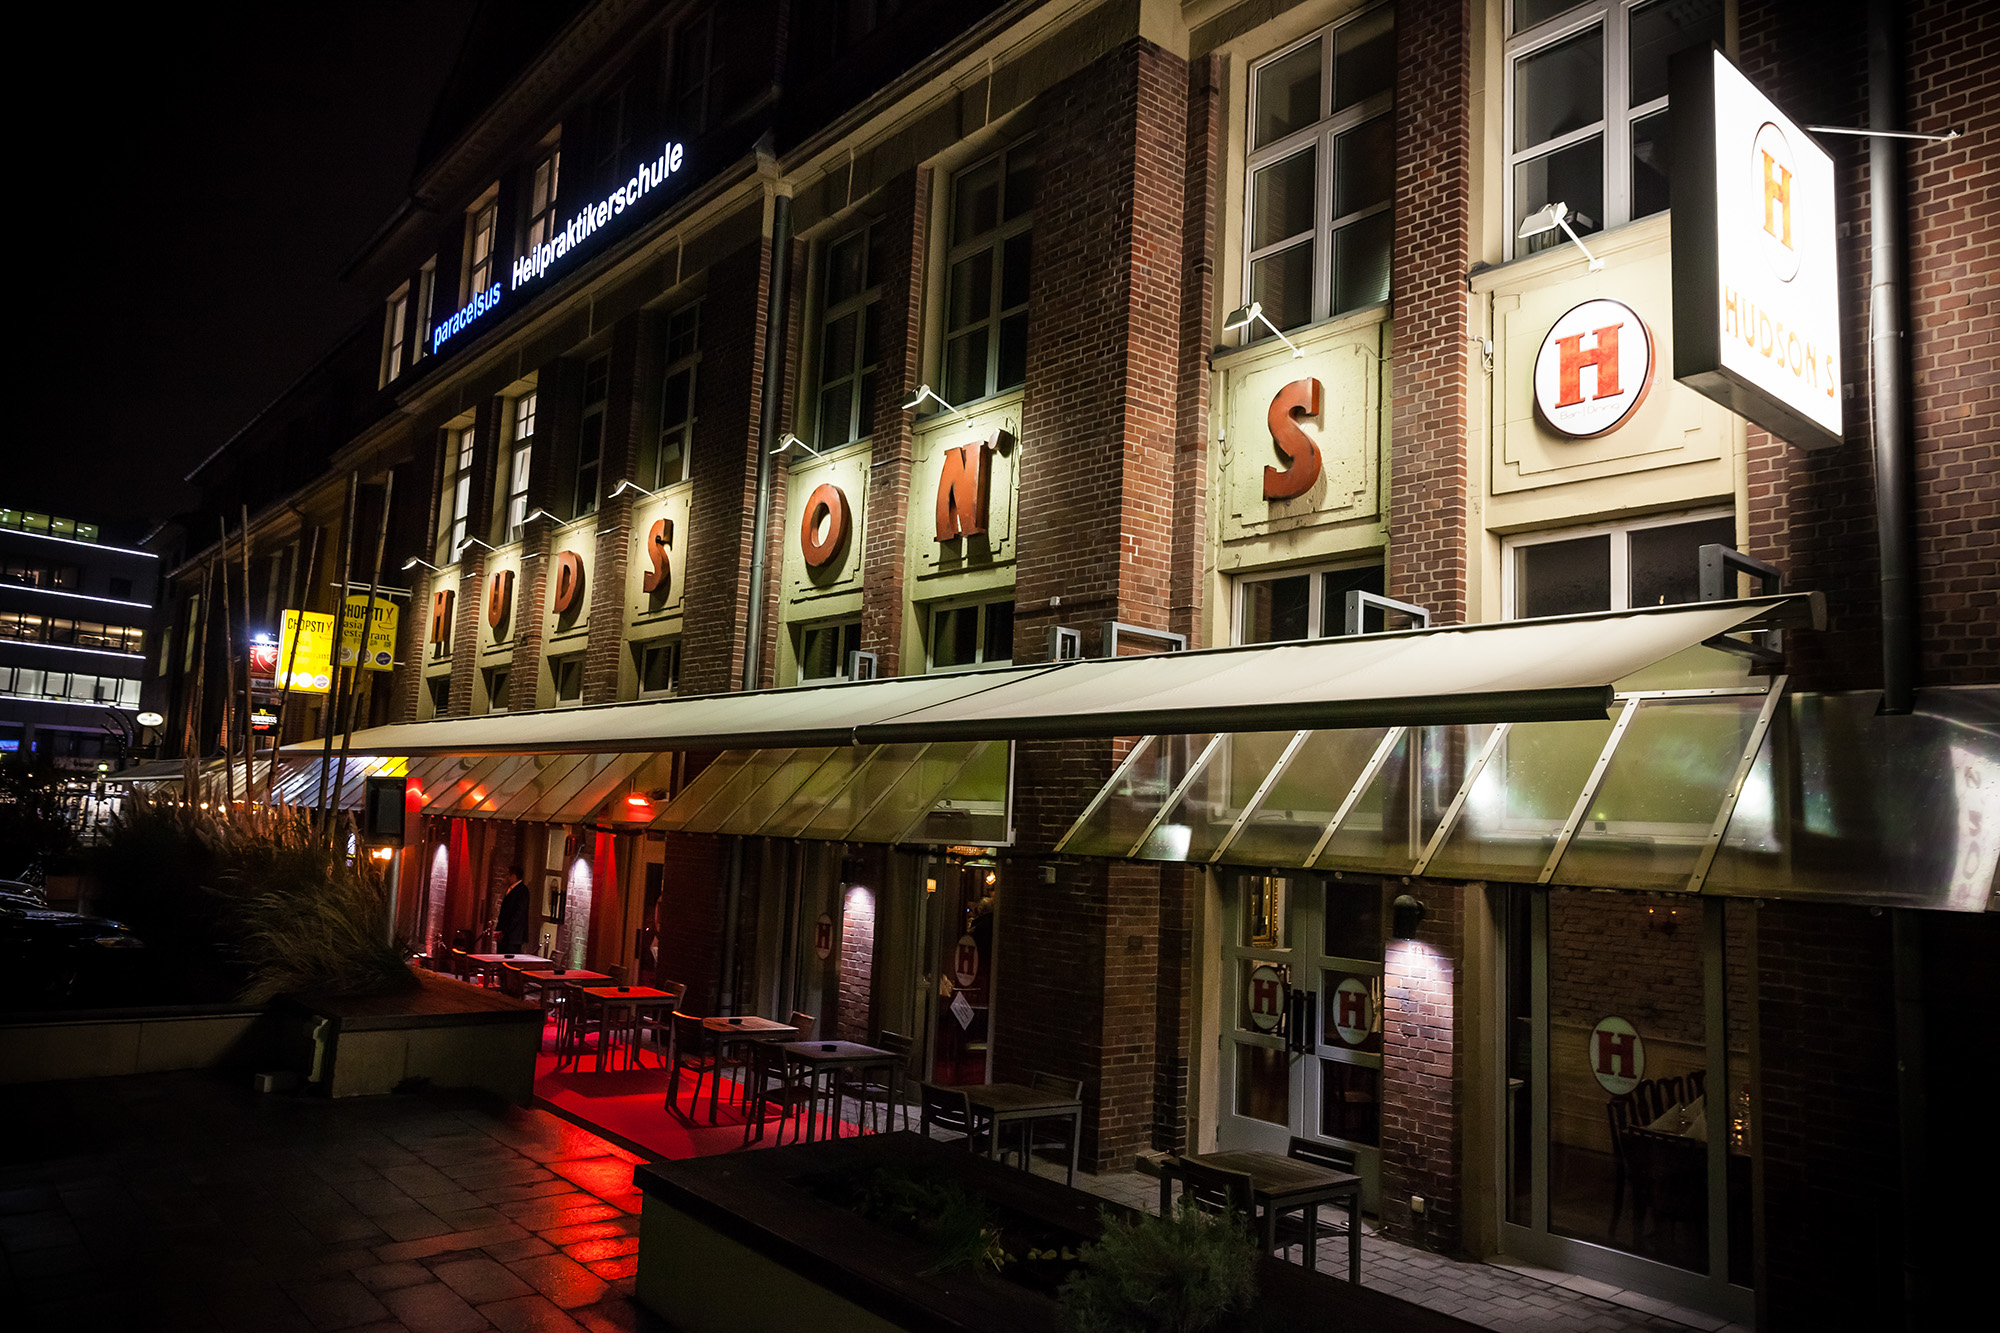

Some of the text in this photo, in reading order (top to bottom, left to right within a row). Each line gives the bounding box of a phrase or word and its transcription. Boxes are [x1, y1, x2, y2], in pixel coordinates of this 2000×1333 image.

[1761, 149, 1793, 251] H
[434, 141, 684, 353] paracelsus Heilpraktikerschule
[1554, 322, 1625, 408] H
[816, 923, 831, 950] H
[957, 944, 975, 975] H
[1252, 979, 1279, 1016] H
[1338, 990, 1367, 1030] H
[1596, 1030, 1637, 1079] H
